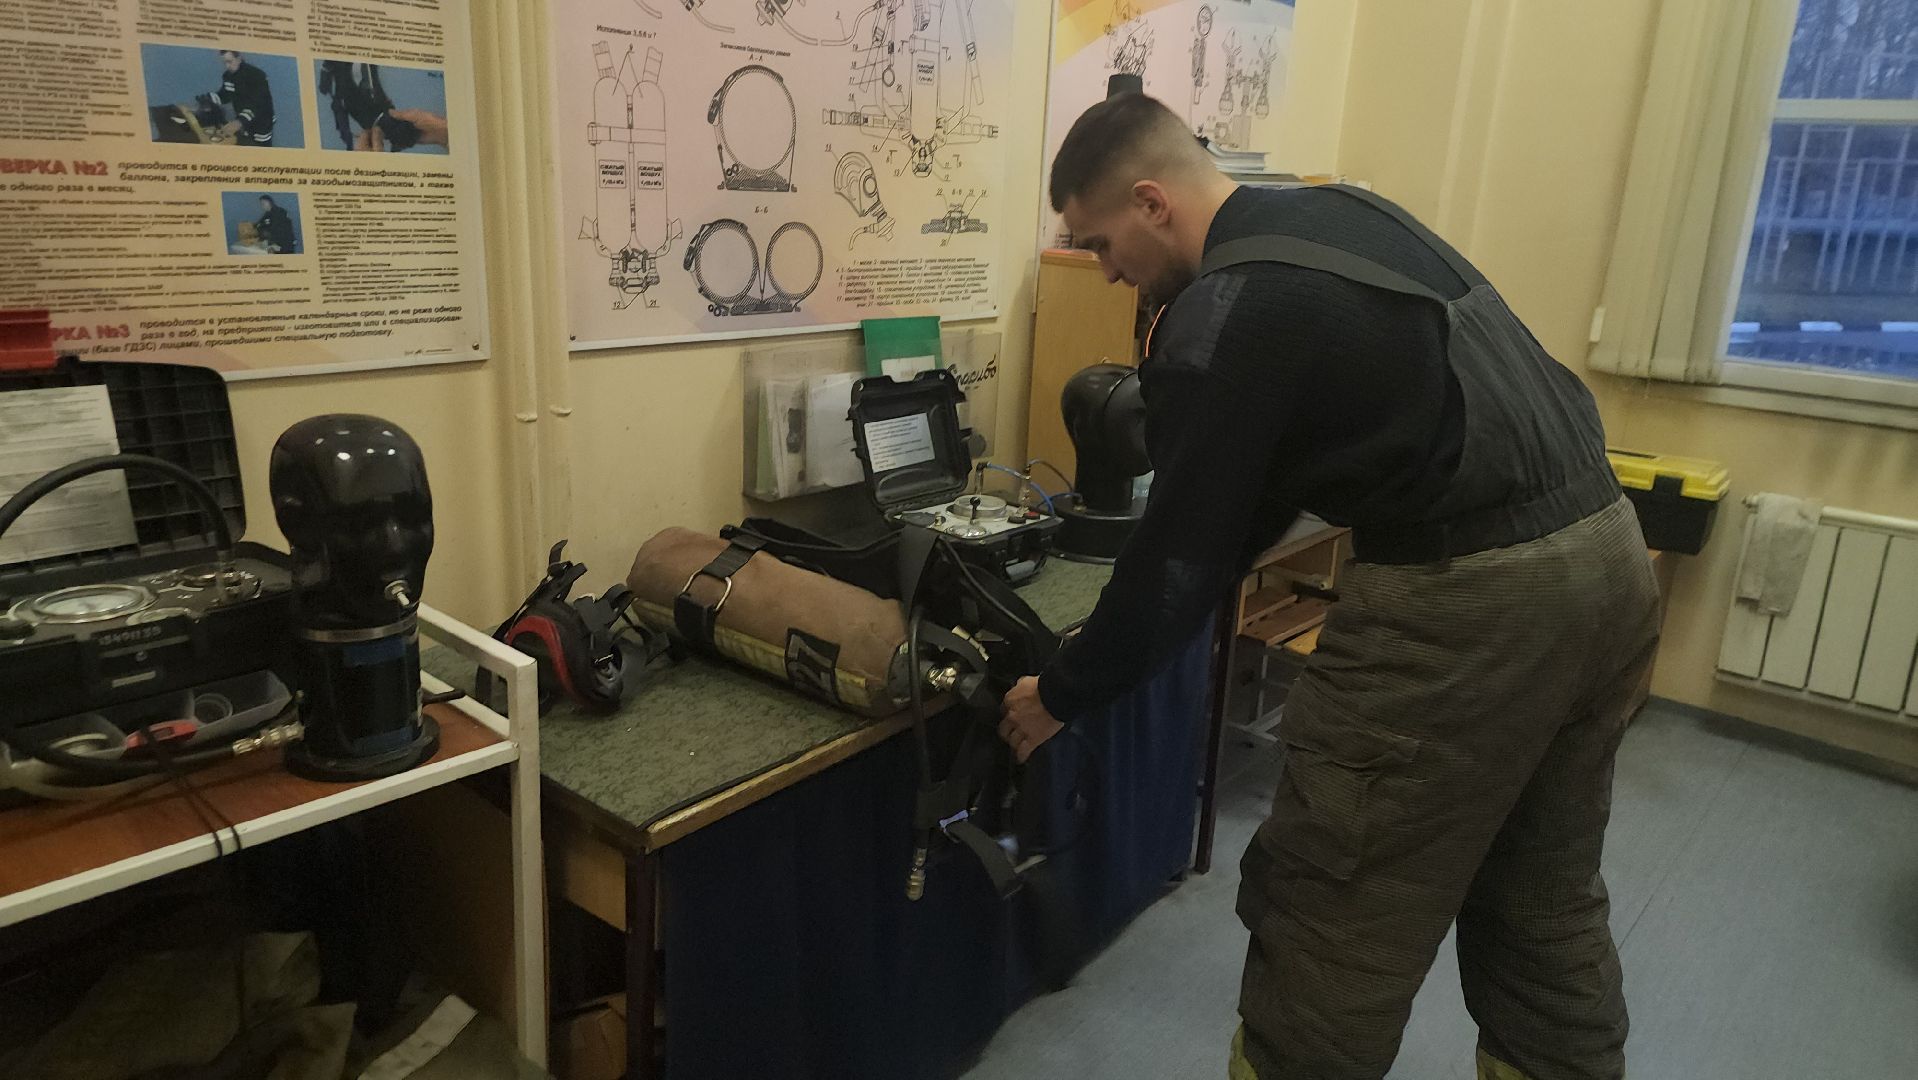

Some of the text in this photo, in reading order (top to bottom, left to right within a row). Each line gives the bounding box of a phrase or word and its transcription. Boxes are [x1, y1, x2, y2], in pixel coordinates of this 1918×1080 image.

[73, 160, 108, 176] №2
[118, 162, 188, 172] проводится
[200, 164, 248, 174] процессе
[251, 167, 322, 177] эксплуатации
[324, 168, 351, 176] после
[120, 173, 170, 184] баллона,
[174, 175, 241, 184] закрепления
[244, 177, 293, 187] аппарата
[10, 182, 54, 192] одного
[57, 185, 84, 193] раза
[97, 185, 136, 194] месяц.
[139, 318, 206, 329] проводится
[217, 313, 296, 326] установленные
[298, 310, 358, 320] календарные
[360, 309, 387, 319] сроки,
[412, 307, 432, 316] реже
[433, 305, 462, 314] одного
[96, 324, 130, 339] №3
[141, 332, 165, 341] раза
[177, 328, 199, 337] год,
[217, 325, 286, 336] предприятии
[294, 320, 361, 331] изготовителе
[92, 344, 121, 355] (базе
[122, 341, 157, 353] ГДЗС)
[159, 341, 201, 350] лицами,
[204, 336, 271, 348] прошедшими
[274, 331, 337, 342] специальную
[339, 327, 394, 338] подготовку.
